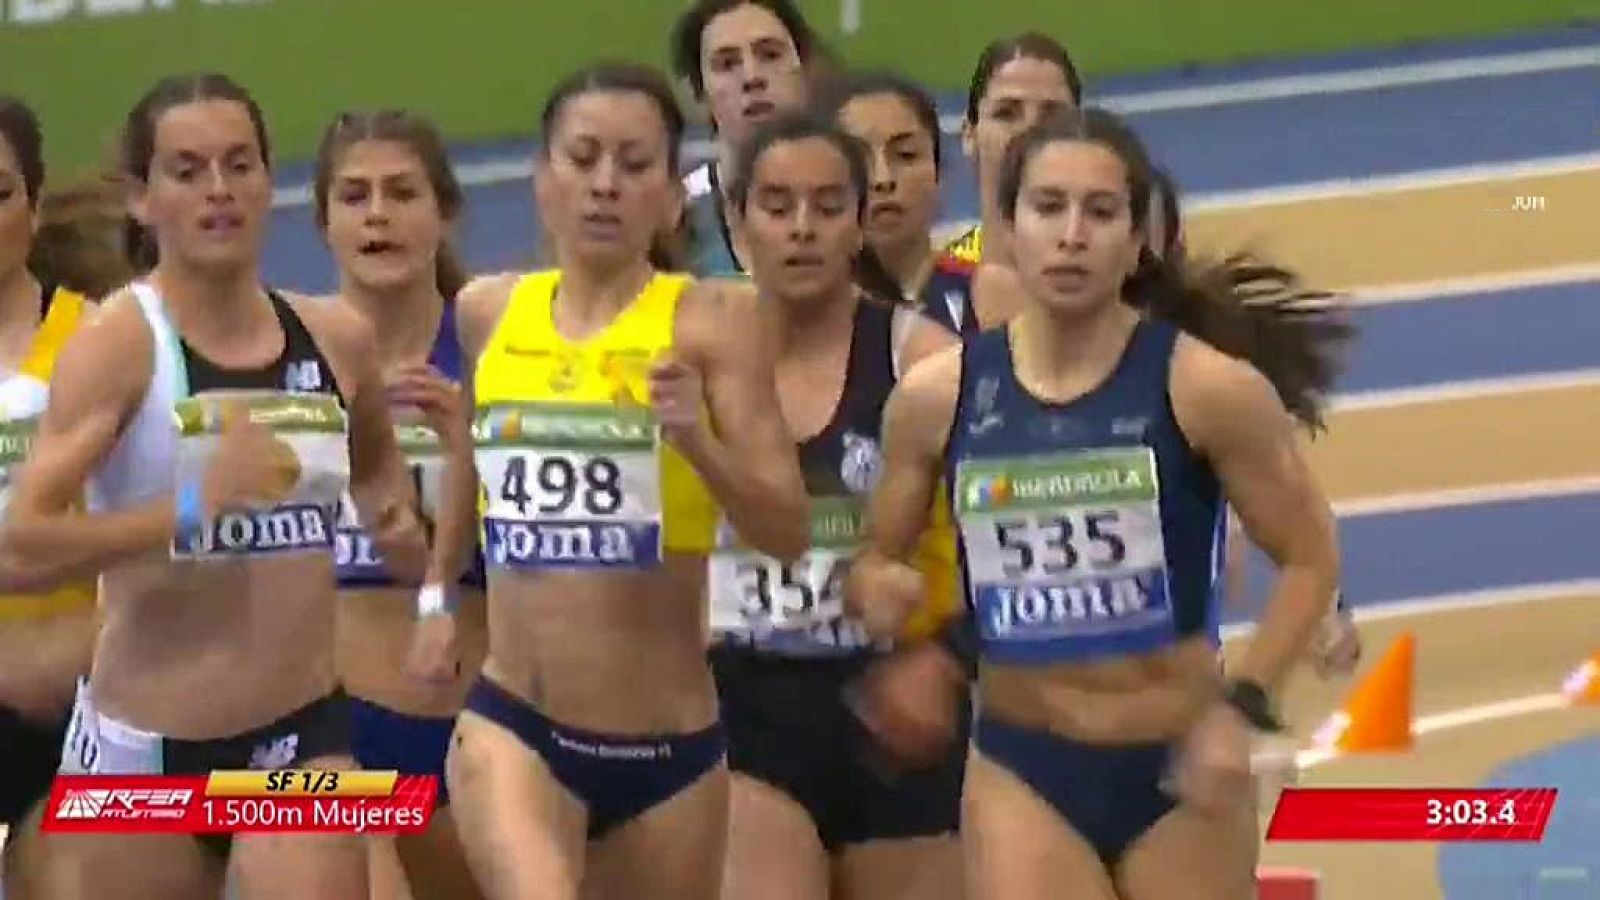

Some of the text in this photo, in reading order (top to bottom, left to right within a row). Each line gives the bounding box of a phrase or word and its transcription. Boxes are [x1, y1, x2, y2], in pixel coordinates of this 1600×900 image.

[502, 455, 622, 516] 498
[487, 523, 636, 564] Joma
[994, 511, 1126, 576] 535
[990, 574, 1151, 638] Joma
